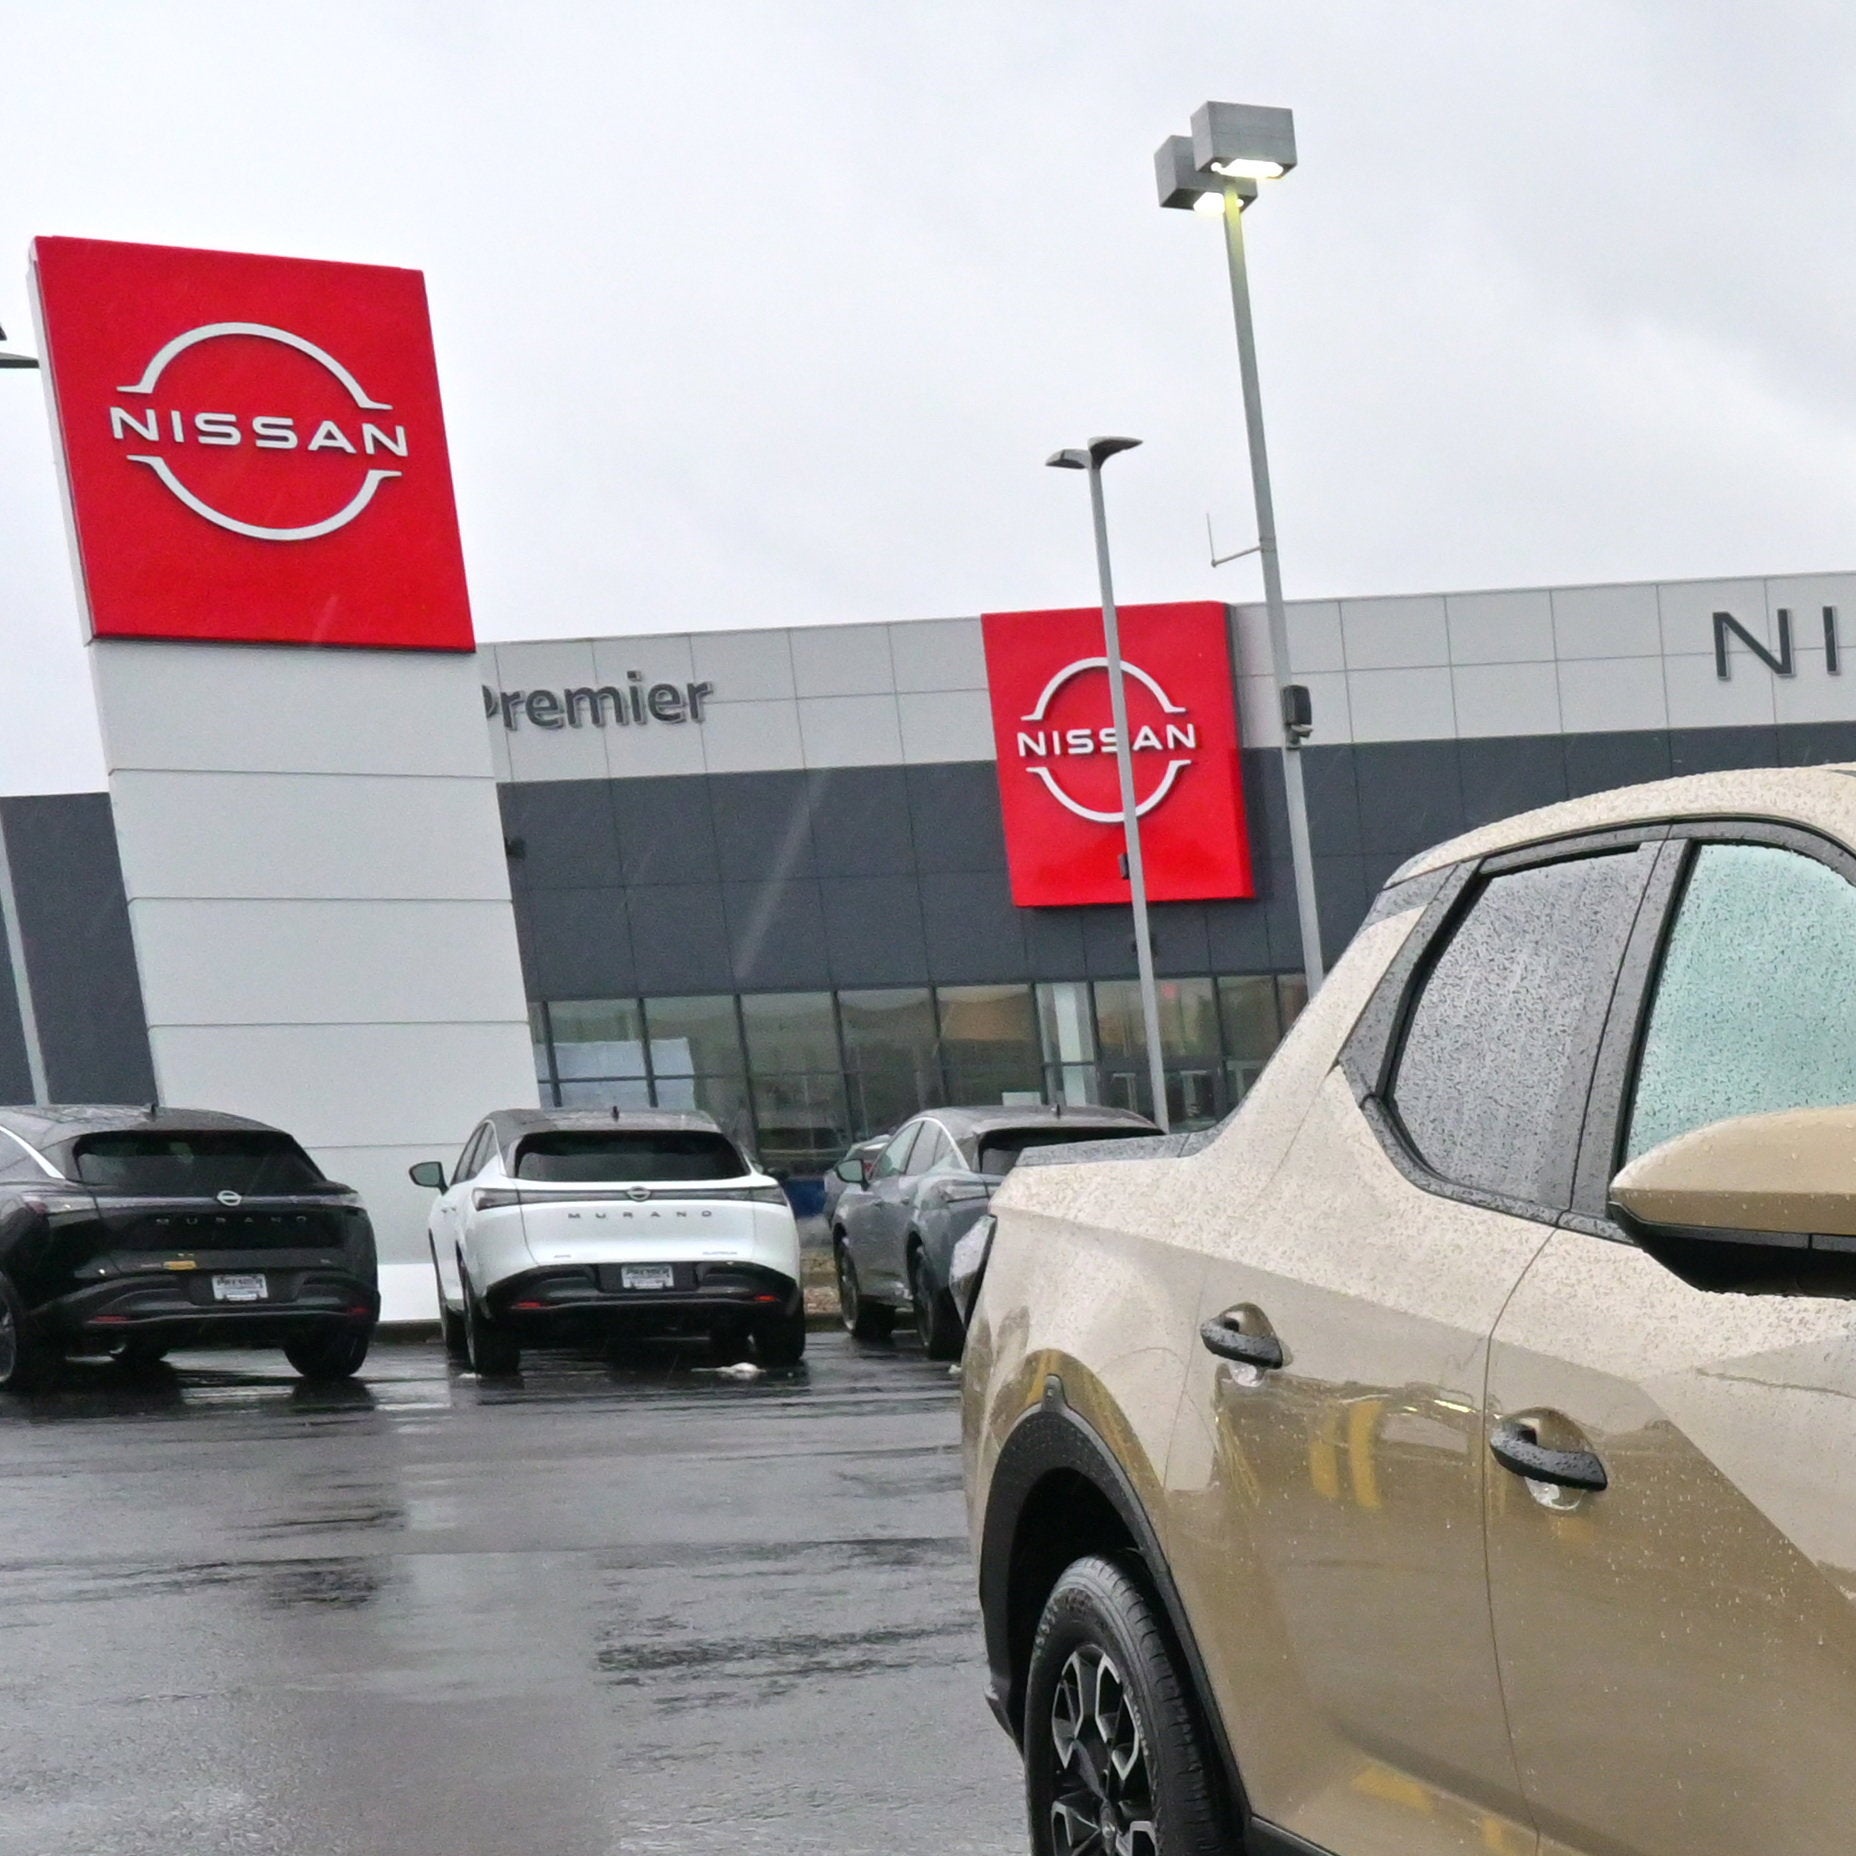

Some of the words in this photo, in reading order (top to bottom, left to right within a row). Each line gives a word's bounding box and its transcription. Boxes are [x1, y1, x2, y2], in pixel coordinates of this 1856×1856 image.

[109, 405, 409, 457] NISSAN
[1016, 722, 1197, 758] NISSAN
[566, 1209, 713, 1219] MURANO
